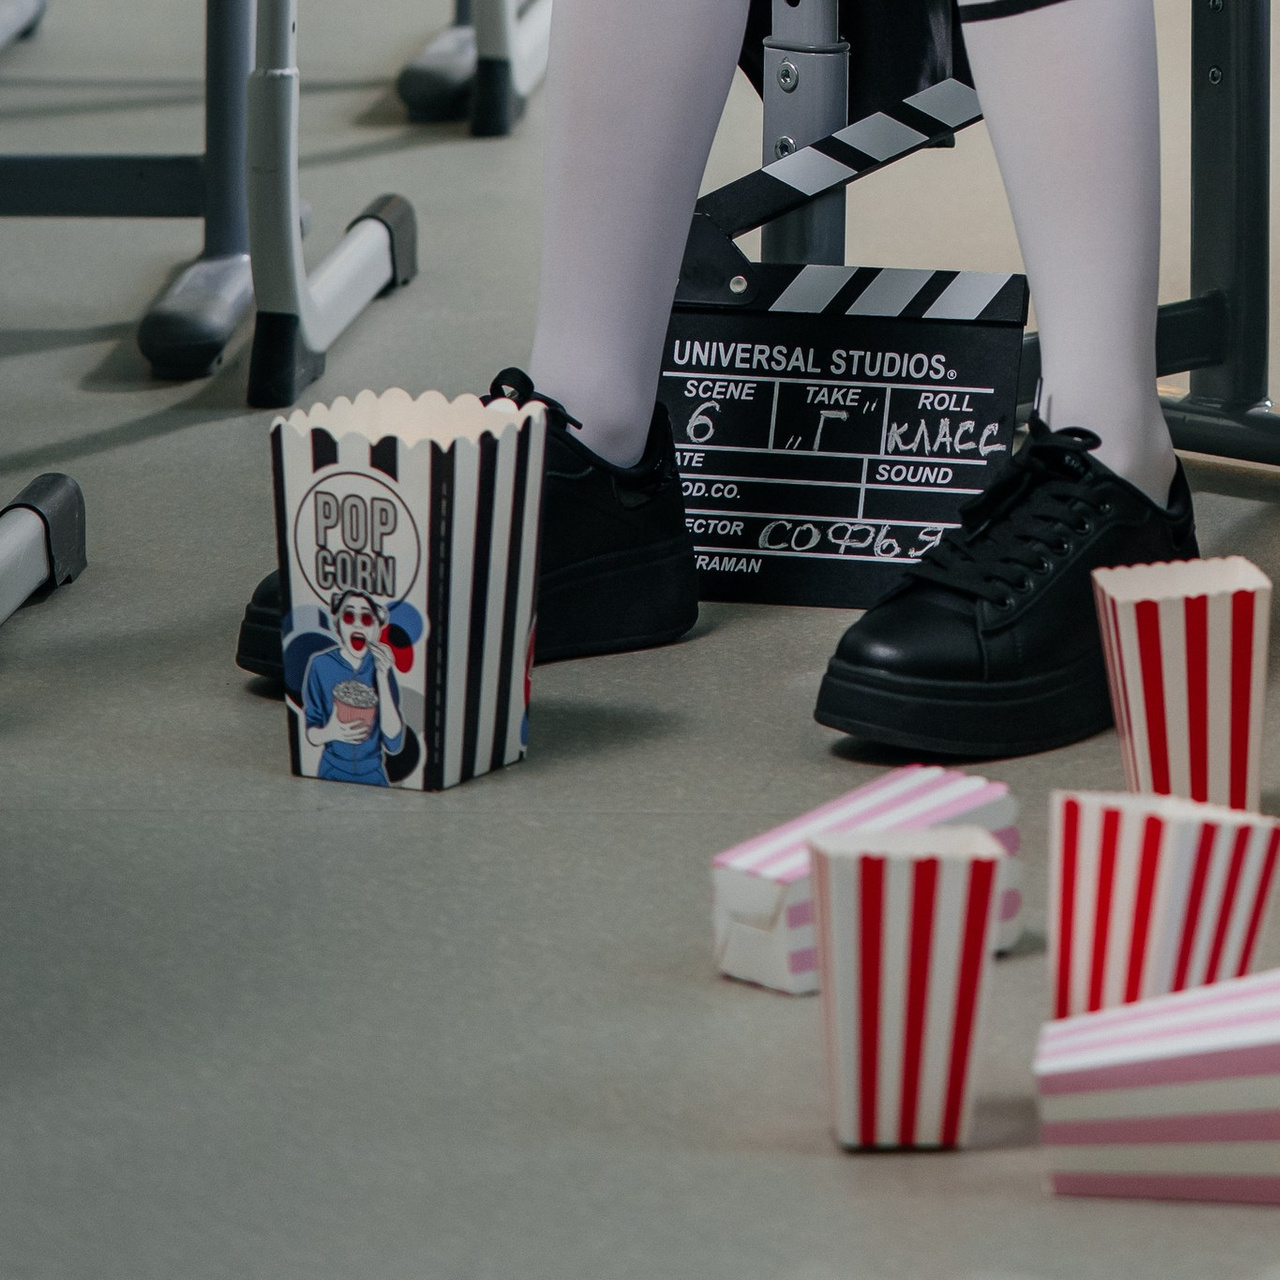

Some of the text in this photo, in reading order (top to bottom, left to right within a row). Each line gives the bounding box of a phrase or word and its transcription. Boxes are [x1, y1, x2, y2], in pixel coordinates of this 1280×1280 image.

[673, 339, 821, 374] UNIVERSAL
[684, 380, 757, 400] SCENE
[806, 386, 862, 406] TAKE
[918, 392, 974, 412] ROLL
[686, 400, 721, 443] 6
[675, 451, 705, 467] ATE
[875, 464, 953, 485] SOUND
[682, 481, 740, 499] OD.CO.
[314, 491, 398, 555] POP
[685, 518, 744, 536] ECTOR
[316, 548, 396, 598] CORN
[694, 554, 762, 573] RAMAN
